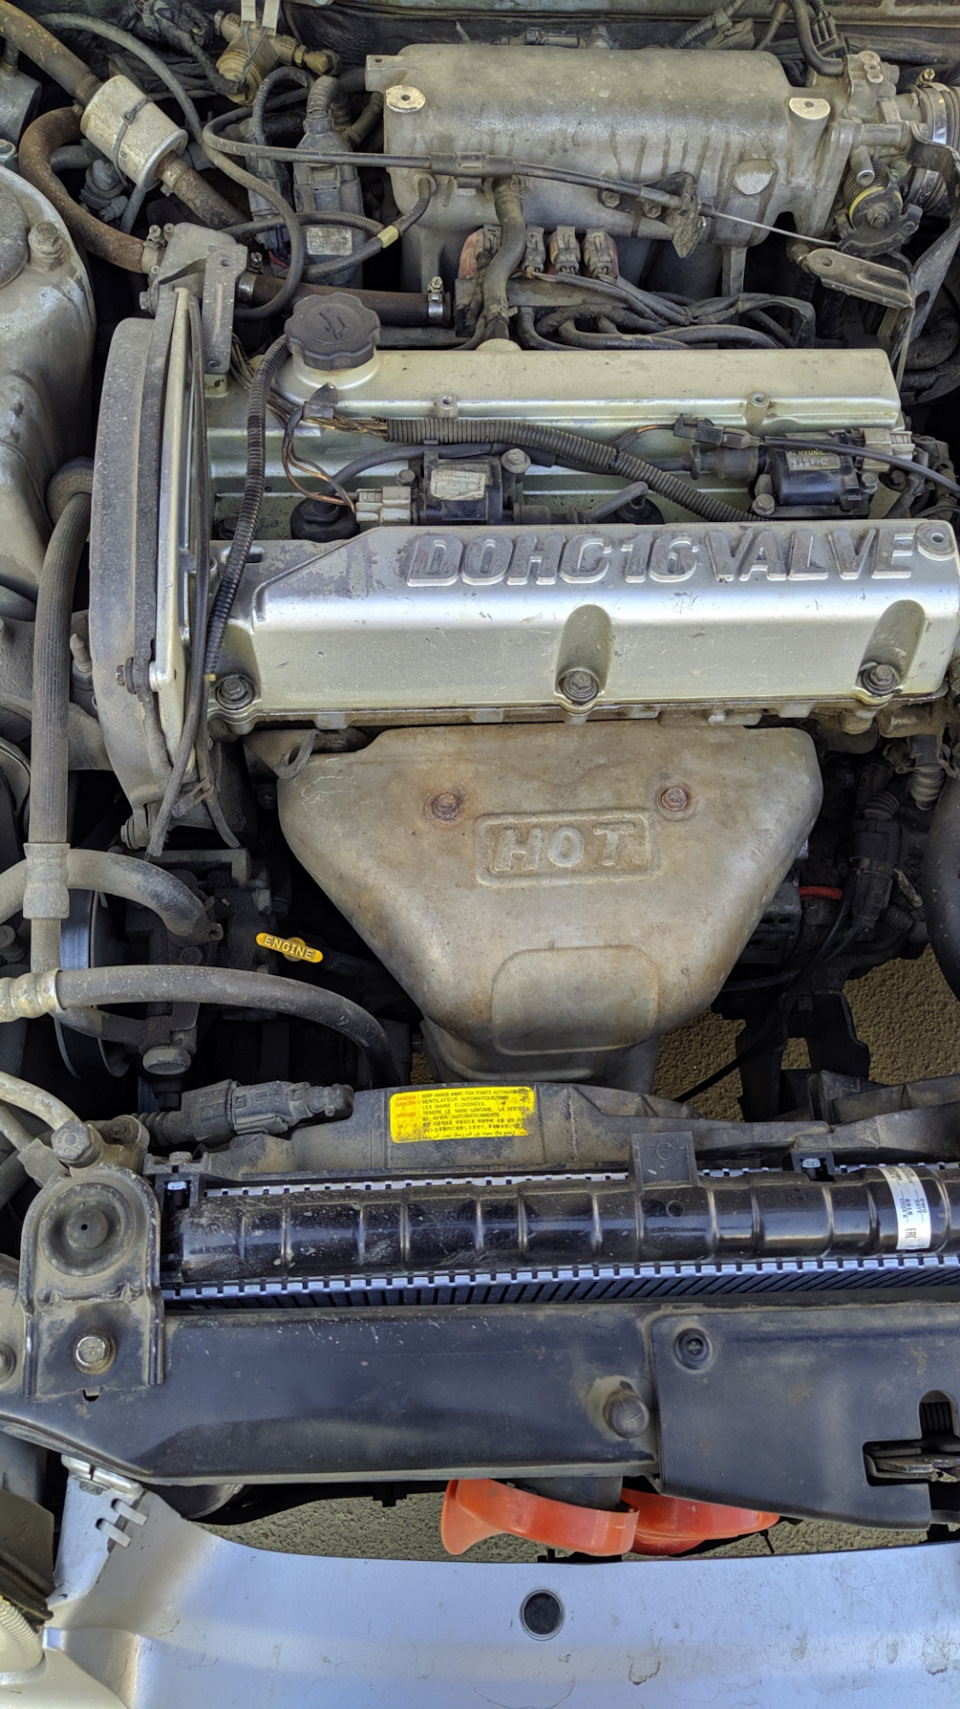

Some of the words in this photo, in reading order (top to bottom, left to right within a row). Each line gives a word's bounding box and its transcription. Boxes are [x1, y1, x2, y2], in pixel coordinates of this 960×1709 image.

[406, 532, 612, 588] DOHC
[620, 531, 701, 584] 16
[704, 526, 916, 583] VALVE
[491, 820, 636, 874] HOT
[264, 935, 314, 960] ENGINE
